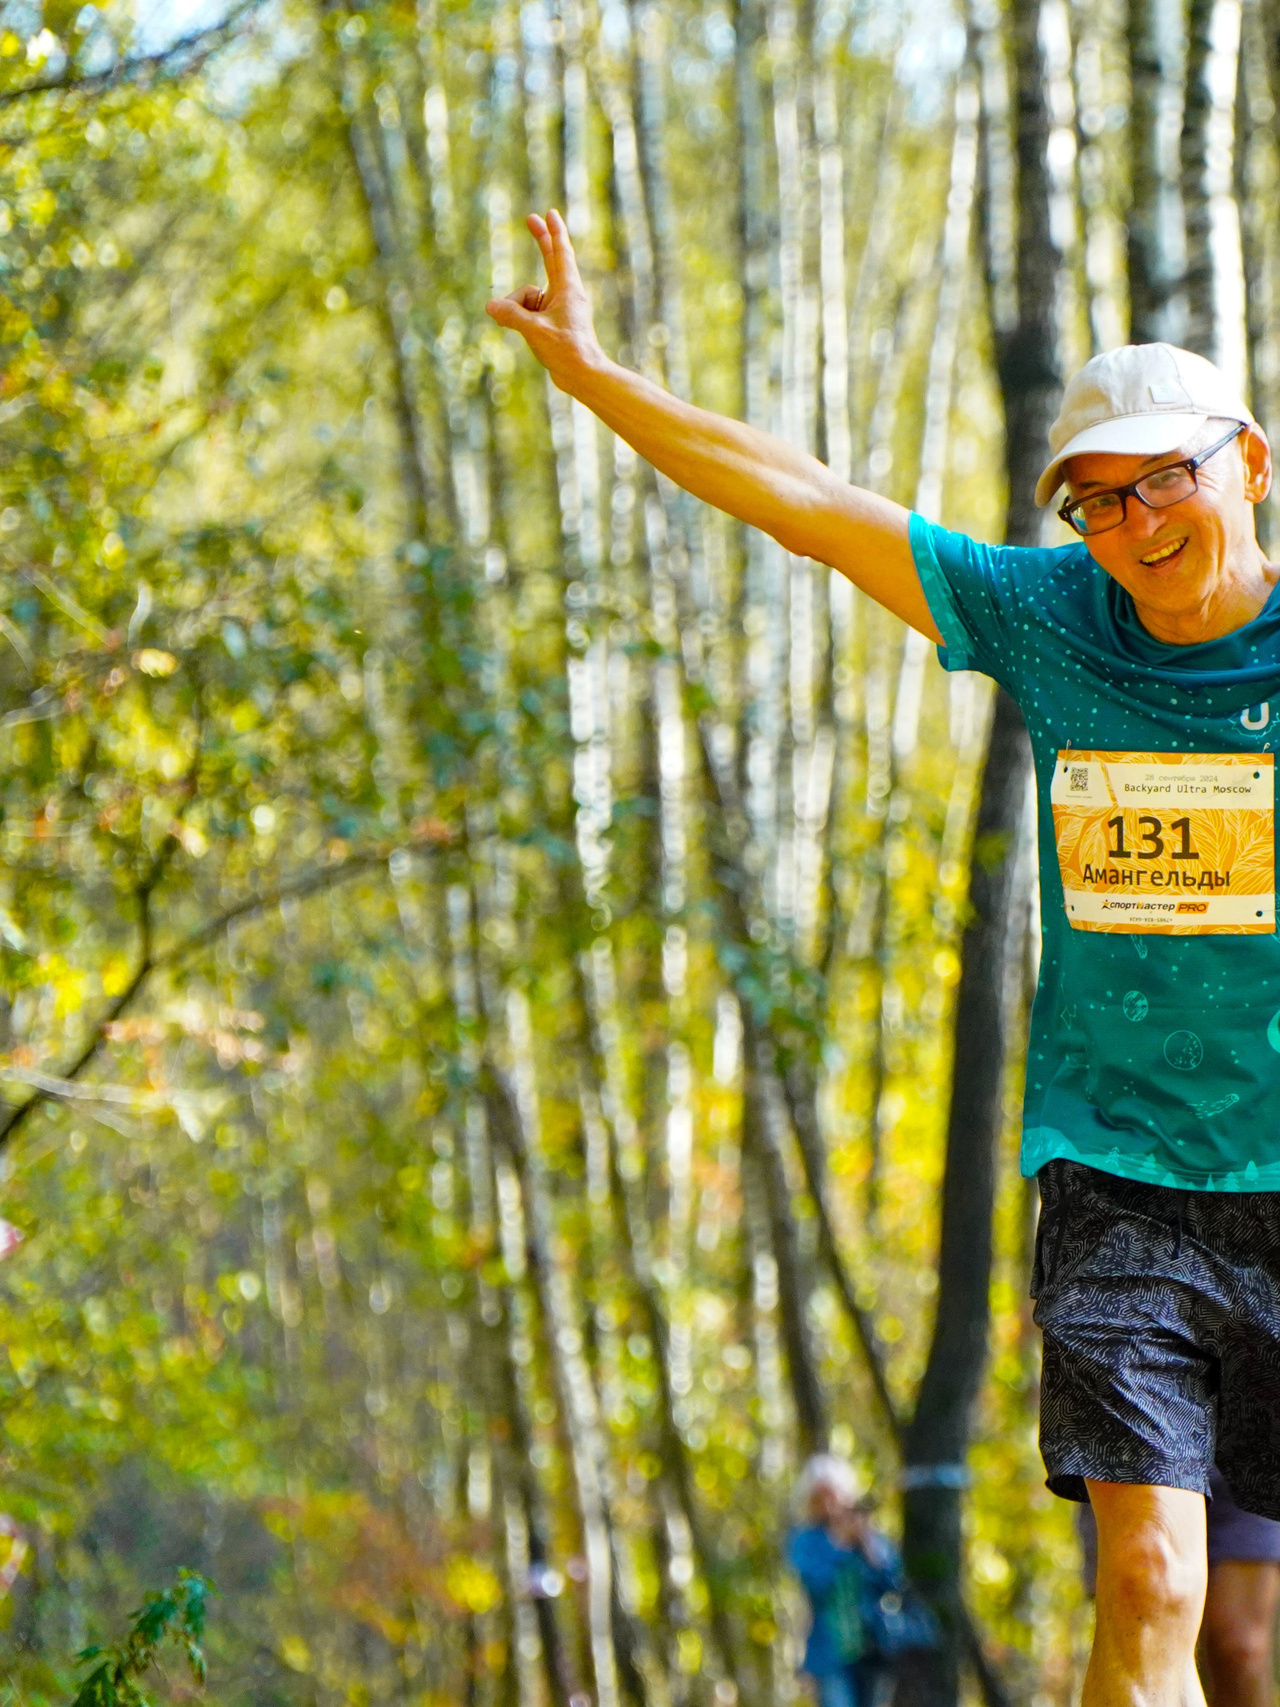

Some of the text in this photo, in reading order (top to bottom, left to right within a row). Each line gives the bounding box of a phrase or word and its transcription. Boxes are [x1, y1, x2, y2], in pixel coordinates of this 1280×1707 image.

[1240, 702, 1269, 730] U
[1159, 774, 1195, 783] сентября
[1124, 783, 1252, 794] Backyard Ultra Moscow
[1107, 816, 1199, 859] 131
[1083, 863, 1230, 890] Амангельды
[1178, 903, 1207, 912] PRO
